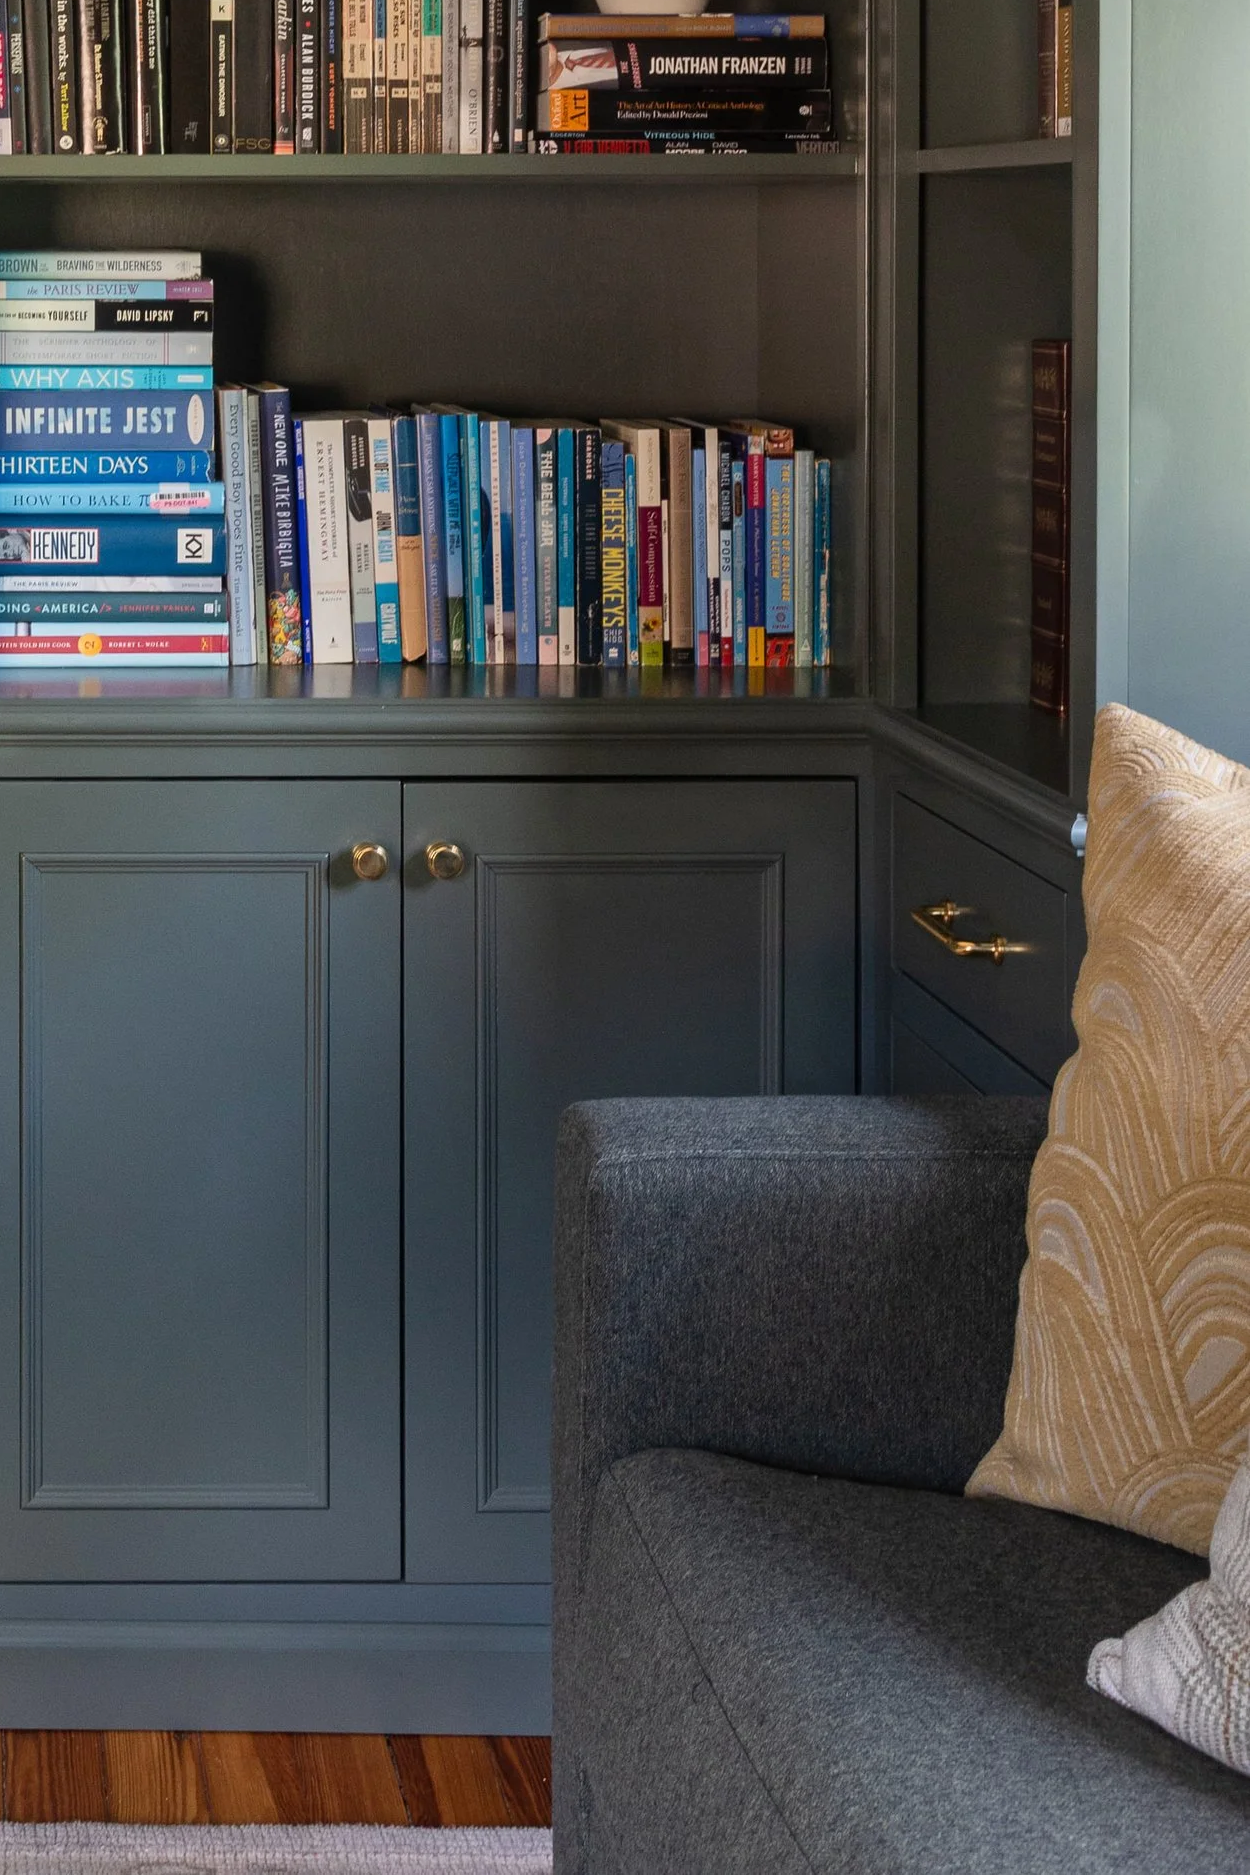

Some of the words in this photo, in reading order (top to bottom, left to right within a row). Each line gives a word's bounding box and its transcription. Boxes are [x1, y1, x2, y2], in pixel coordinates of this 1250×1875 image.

[218, 34, 226, 61] EATING
[302, 33, 314, 66] ALAN
[218, 62, 226, 77] THE
[649, 57, 719, 74] JONATHAN
[722, 56, 786, 74] FRANZEN
[218, 78, 226, 117] DINOSAUR
[301, 68, 314, 120] BURDICK
[570, 93, 587, 129] Art
[644, 130, 690, 140] VITREOUS
[692, 130, 716, 140] HIDE
[48, 310, 88, 322] YOURSELF
[116, 309, 141, 322] DAVID
[144, 309, 174, 322] LIPSKY
[10, 369, 72, 387] WHY
[77, 369, 134, 388] AXIS
[5, 407, 112, 434] INFINITE
[122, 407, 177, 434] JEST
[98, 456, 149, 474] DAYS
[316, 440, 326, 485] ERNEST
[585, 434, 593, 481] CHANDLER
[272, 474, 291, 509] MIKE
[318, 491, 329, 563] HEMINGWAY
[601, 488, 625, 542] CHEESE
[33, 530, 96, 560] KENNEDY
[275, 510, 293, 568] BIRBIGLIA
[646, 511, 659, 603] Self-Compassion
[722, 539, 732, 573] POPS
[51, 580, 79, 588] REVIEW
[601, 546, 625, 628] MONKEYS
